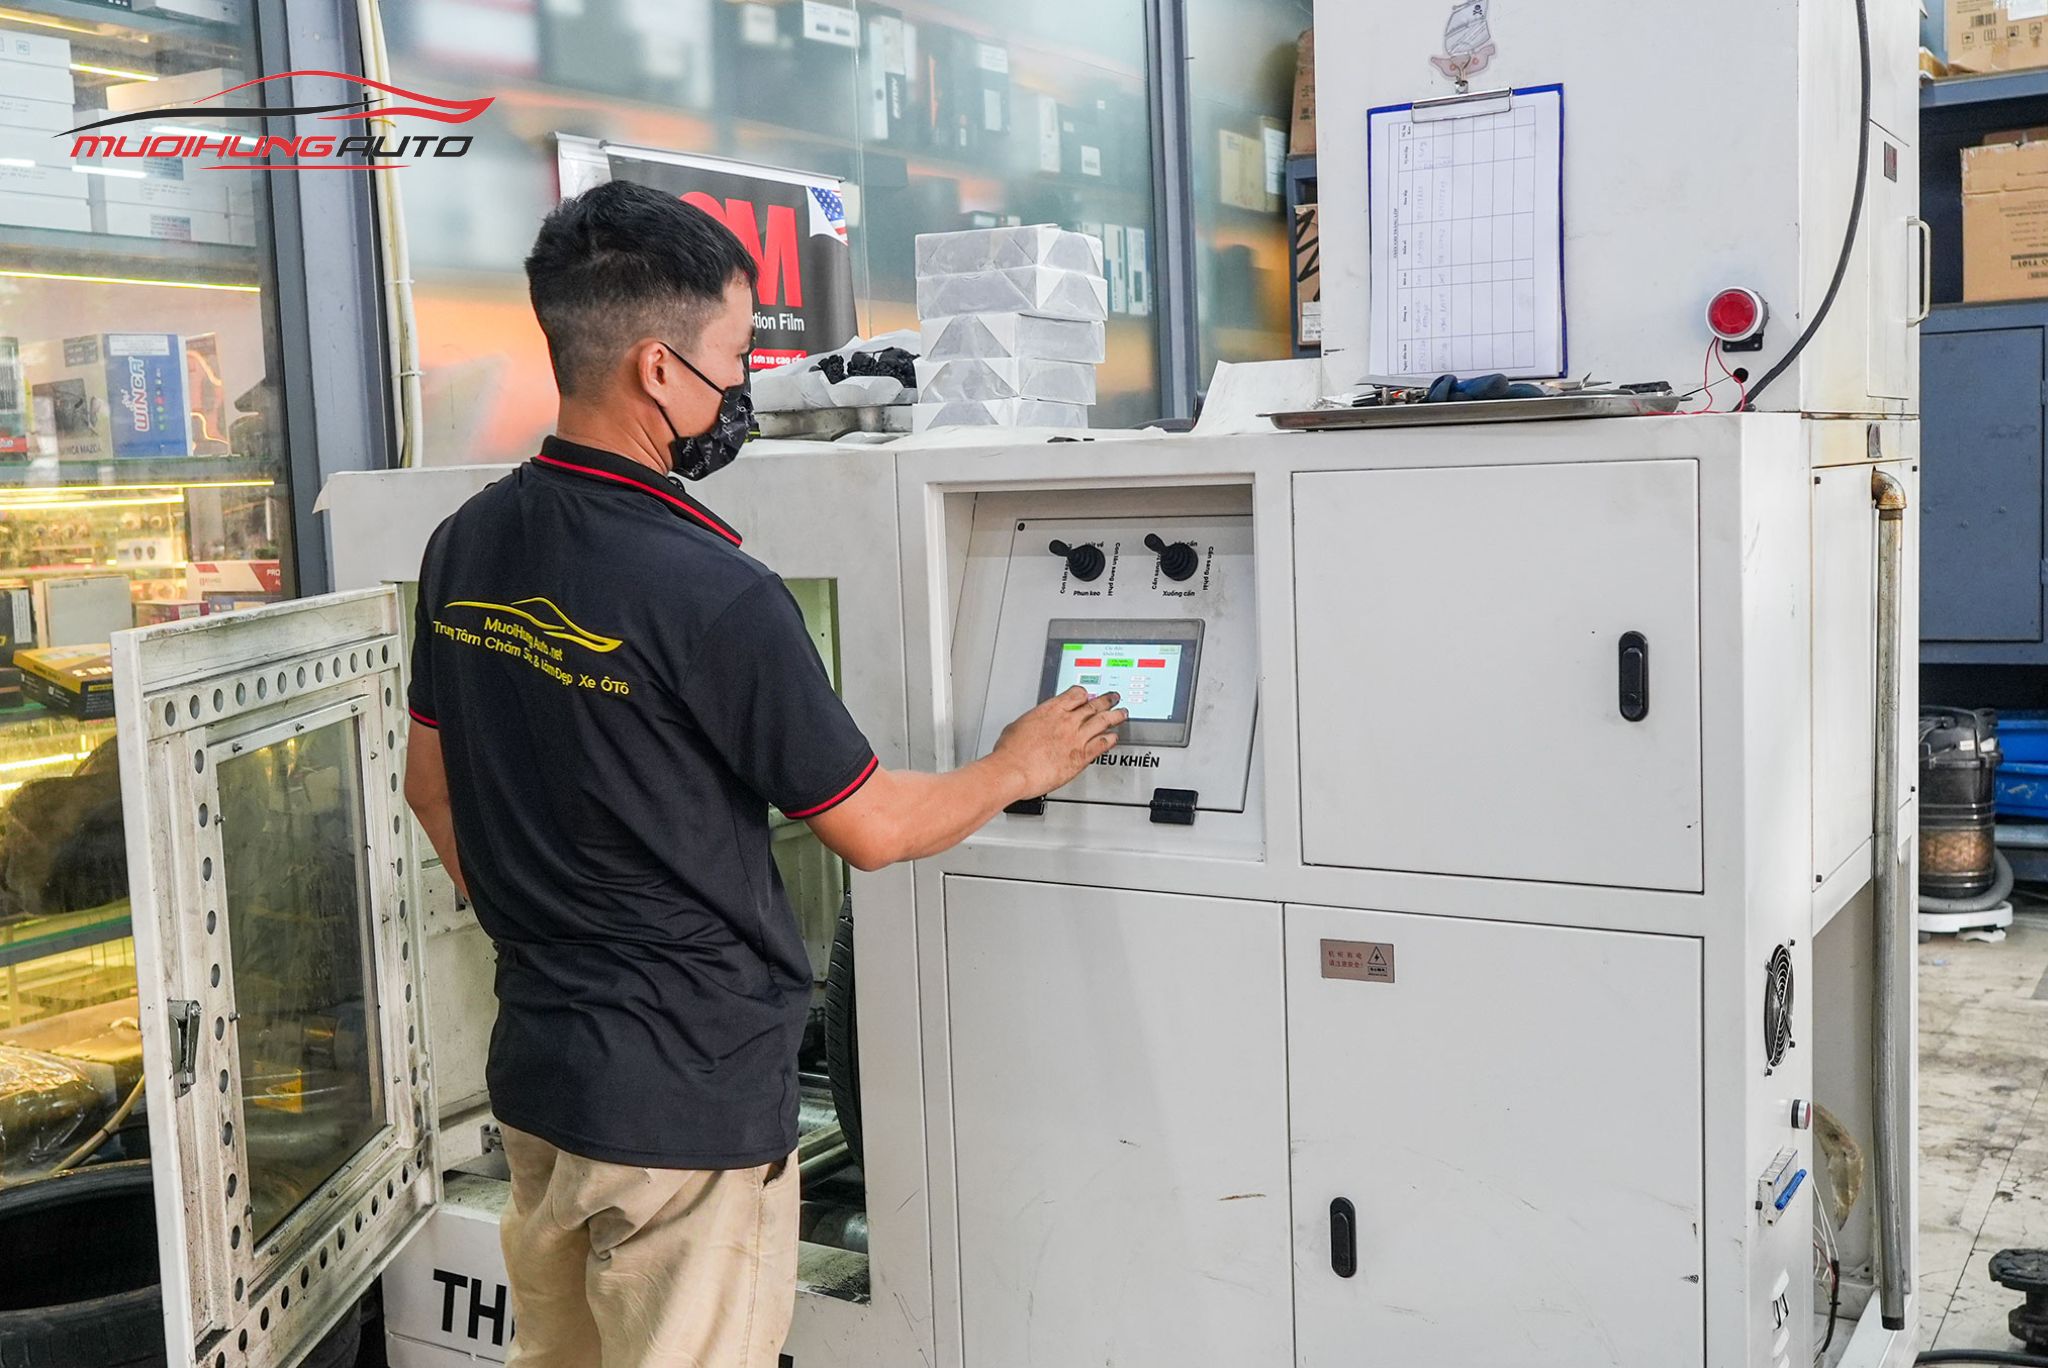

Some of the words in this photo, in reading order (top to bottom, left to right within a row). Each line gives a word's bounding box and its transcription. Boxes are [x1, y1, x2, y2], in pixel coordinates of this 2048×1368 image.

[779, 312, 805, 332] Film
[1109, 566, 1117, 582] sang
[1203, 560, 1211, 576] sang
[455, 627, 481, 647] Tâm
[578, 673, 597, 689] Xe
